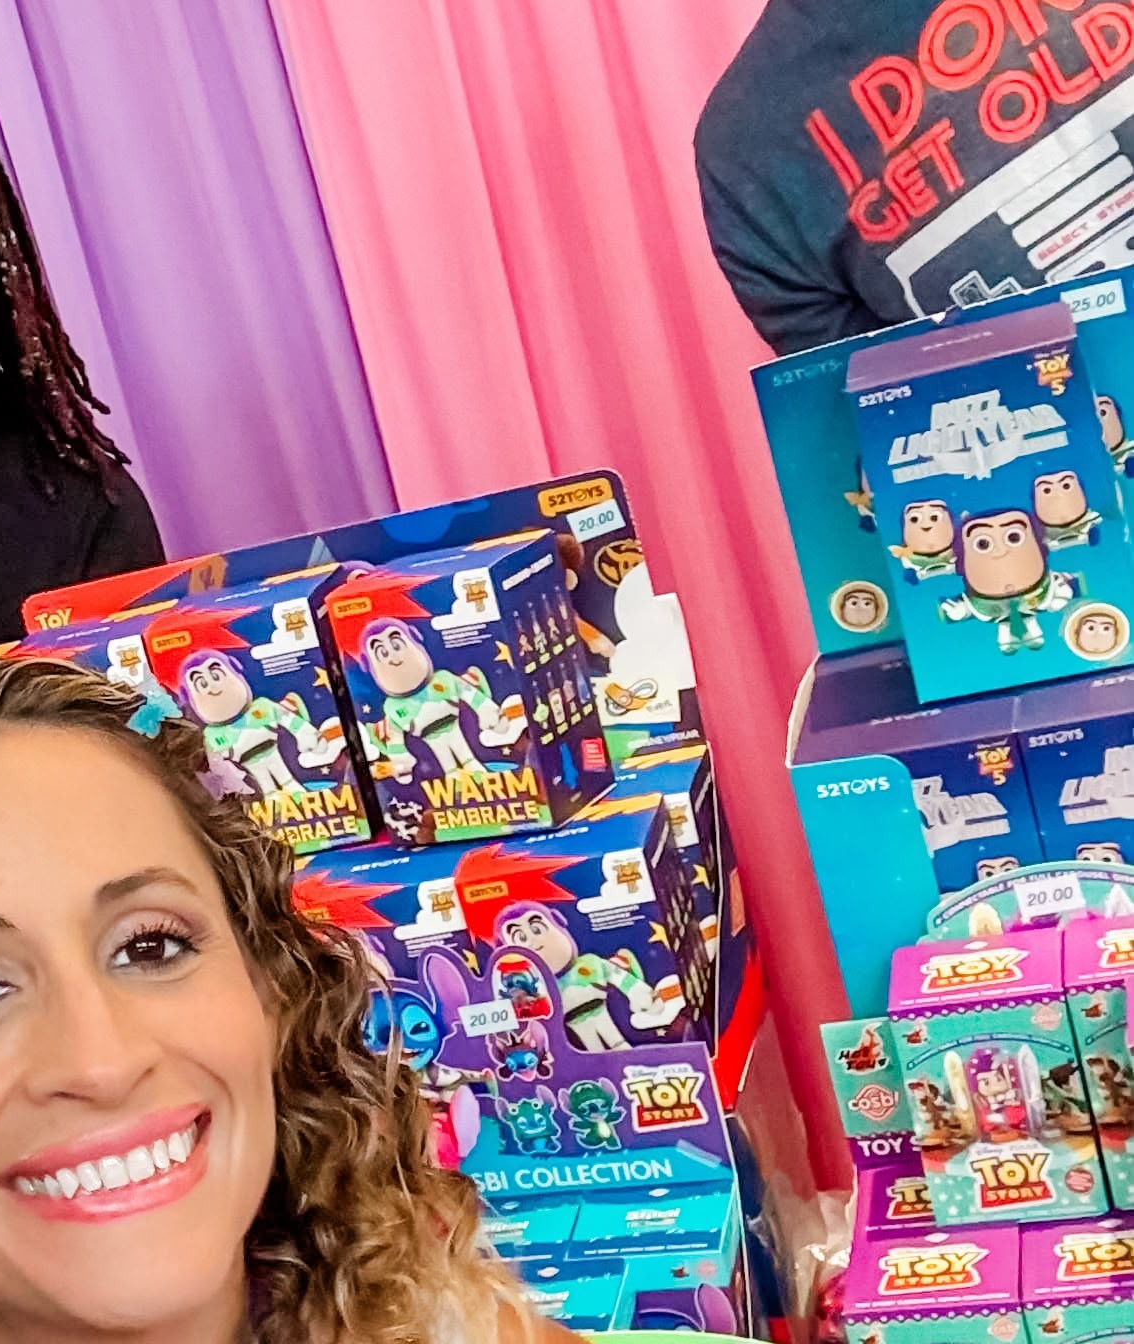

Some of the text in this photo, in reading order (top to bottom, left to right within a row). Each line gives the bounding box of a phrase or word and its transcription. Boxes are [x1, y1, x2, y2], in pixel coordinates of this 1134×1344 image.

[805, 109, 863, 196] I
[847, 118, 965, 243] GET
[1037, 221, 1088, 261] SELECT
[1035, 353, 1071, 373] TOY
[547, 485, 605, 508] 52TOYS
[578, 509, 615, 533] 20.00
[34, 607, 73, 630] TOY
[1028, 727, 1084, 748] 52TOYS
[978, 746, 1010, 764] TOY
[421, 766, 538, 807] WARM
[816, 776, 890, 799] 52TOYS
[249, 783, 358, 827] WARM
[433, 800, 540, 830] EMBRACE
[272, 814, 358, 846] MBRACE
[1027, 886, 1073, 907] 20.00
[932, 953, 1014, 979] TOY
[470, 1008, 509, 1027] 20.00
[627, 1077, 699, 1108] TOY
[641, 1106, 698, 1123] STORY
[857, 1138, 902, 1157] TOY
[472, 1159, 674, 1192] SBI COLLECTION
[970, 1153, 1050, 1188] TOY
[986, 1186, 1045, 1202] STORY
[886, 1250, 981, 1277] TOY
[1071, 1259, 1134, 1273] STOR
